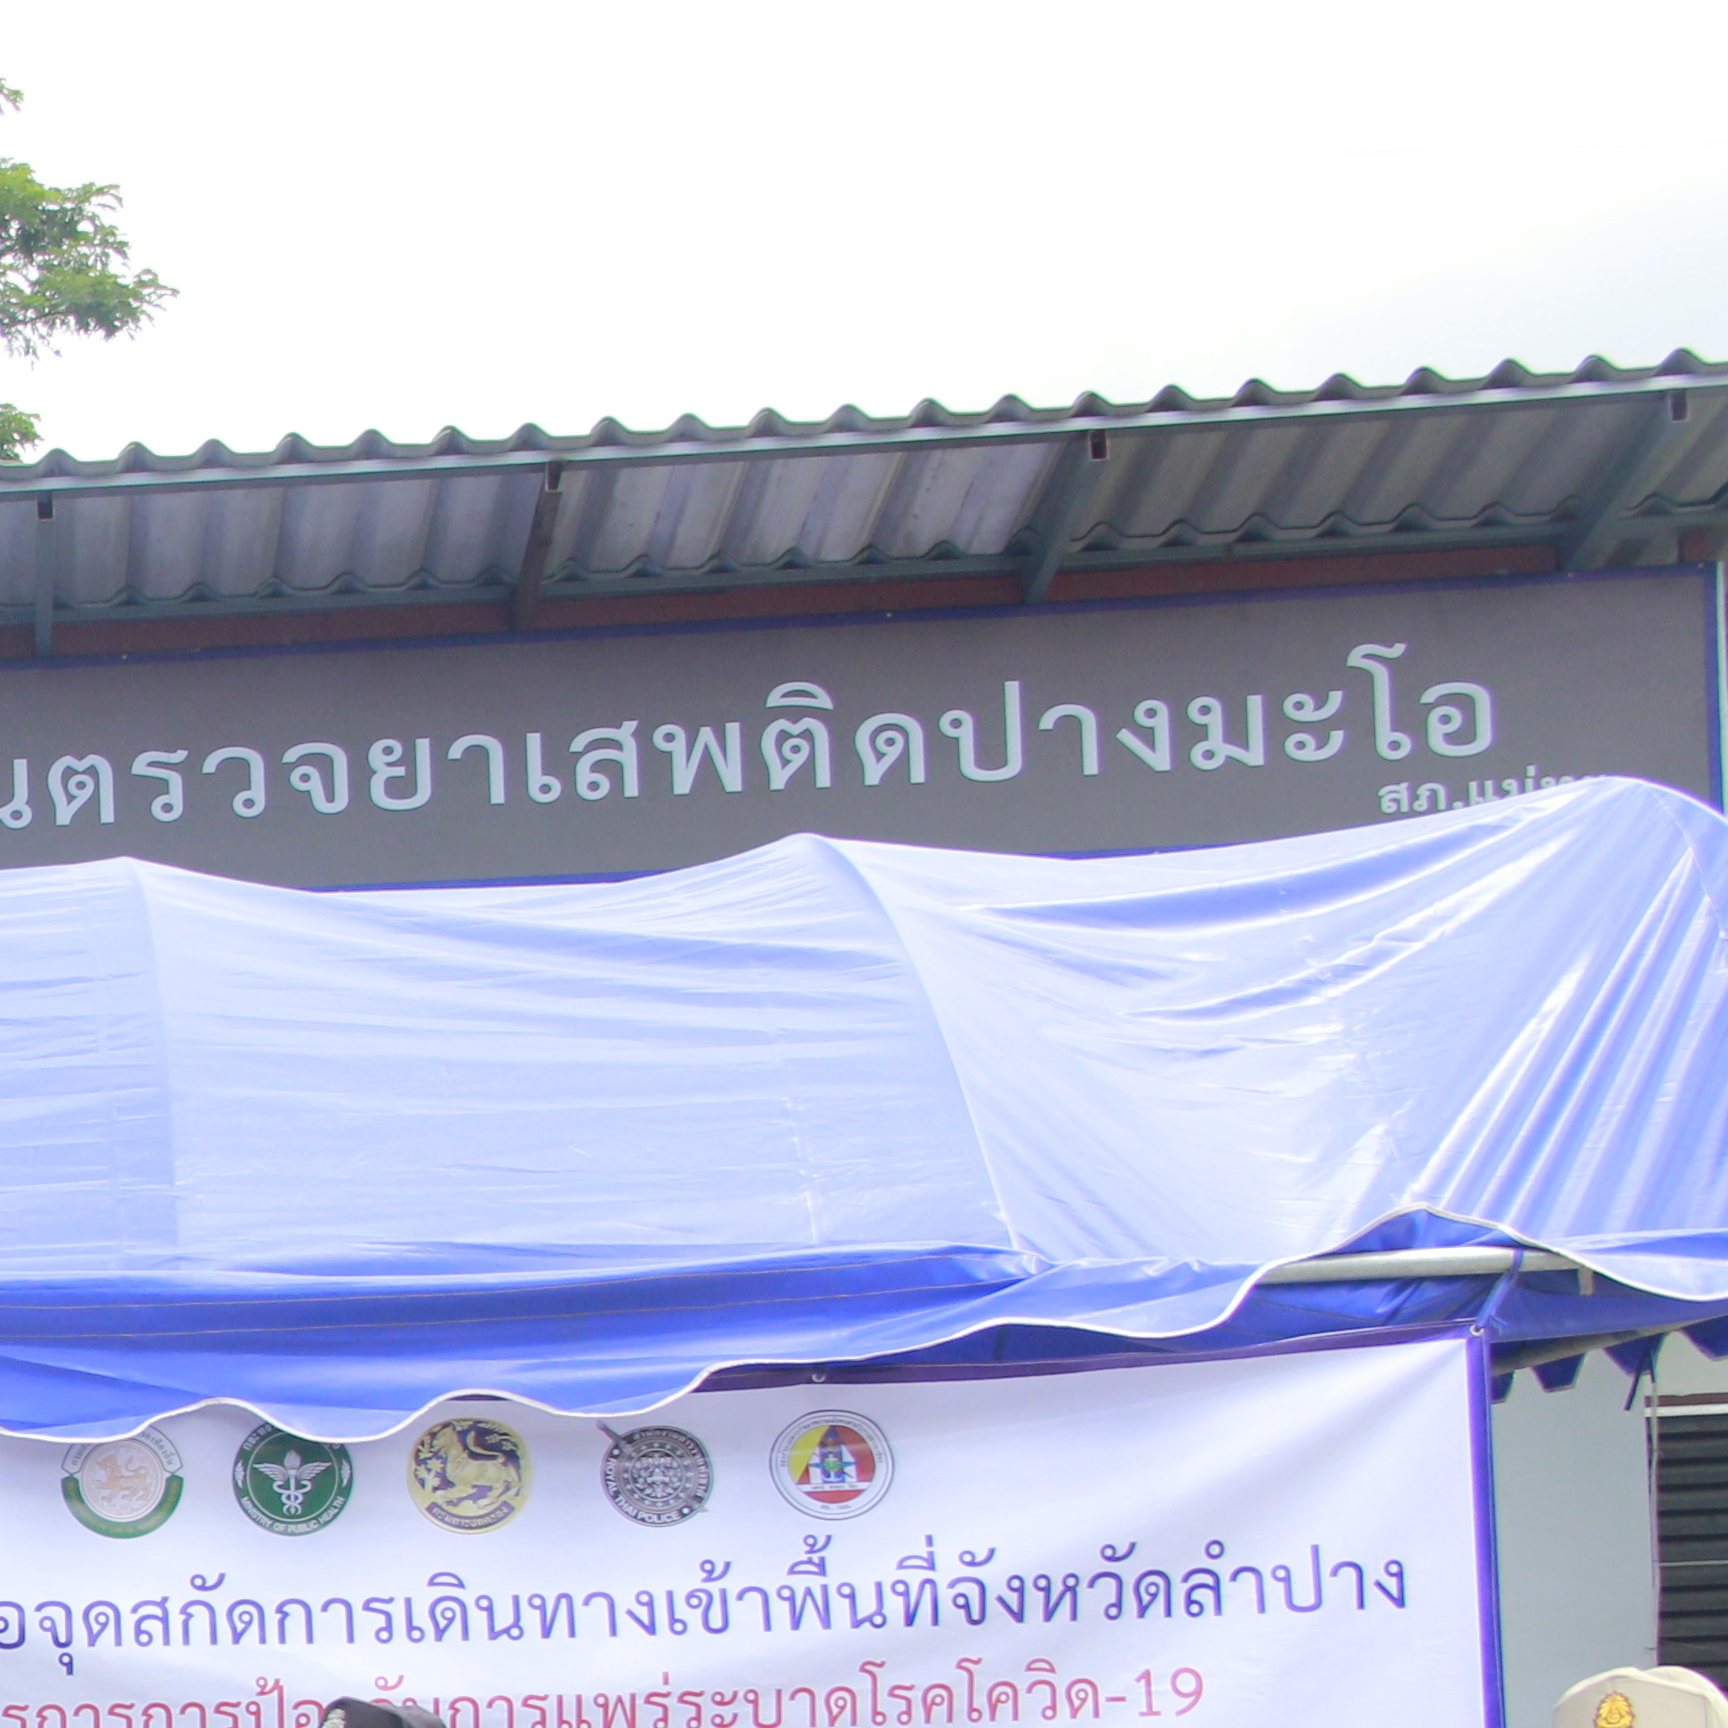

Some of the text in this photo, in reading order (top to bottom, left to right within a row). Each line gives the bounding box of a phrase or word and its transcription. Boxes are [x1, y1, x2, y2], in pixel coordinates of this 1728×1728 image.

[241, 1495, 346, 1534] MINISTRY OF PUBLIC HEALTH
[605, 1457, 681, 1524] ROYAL THAI POLICE
